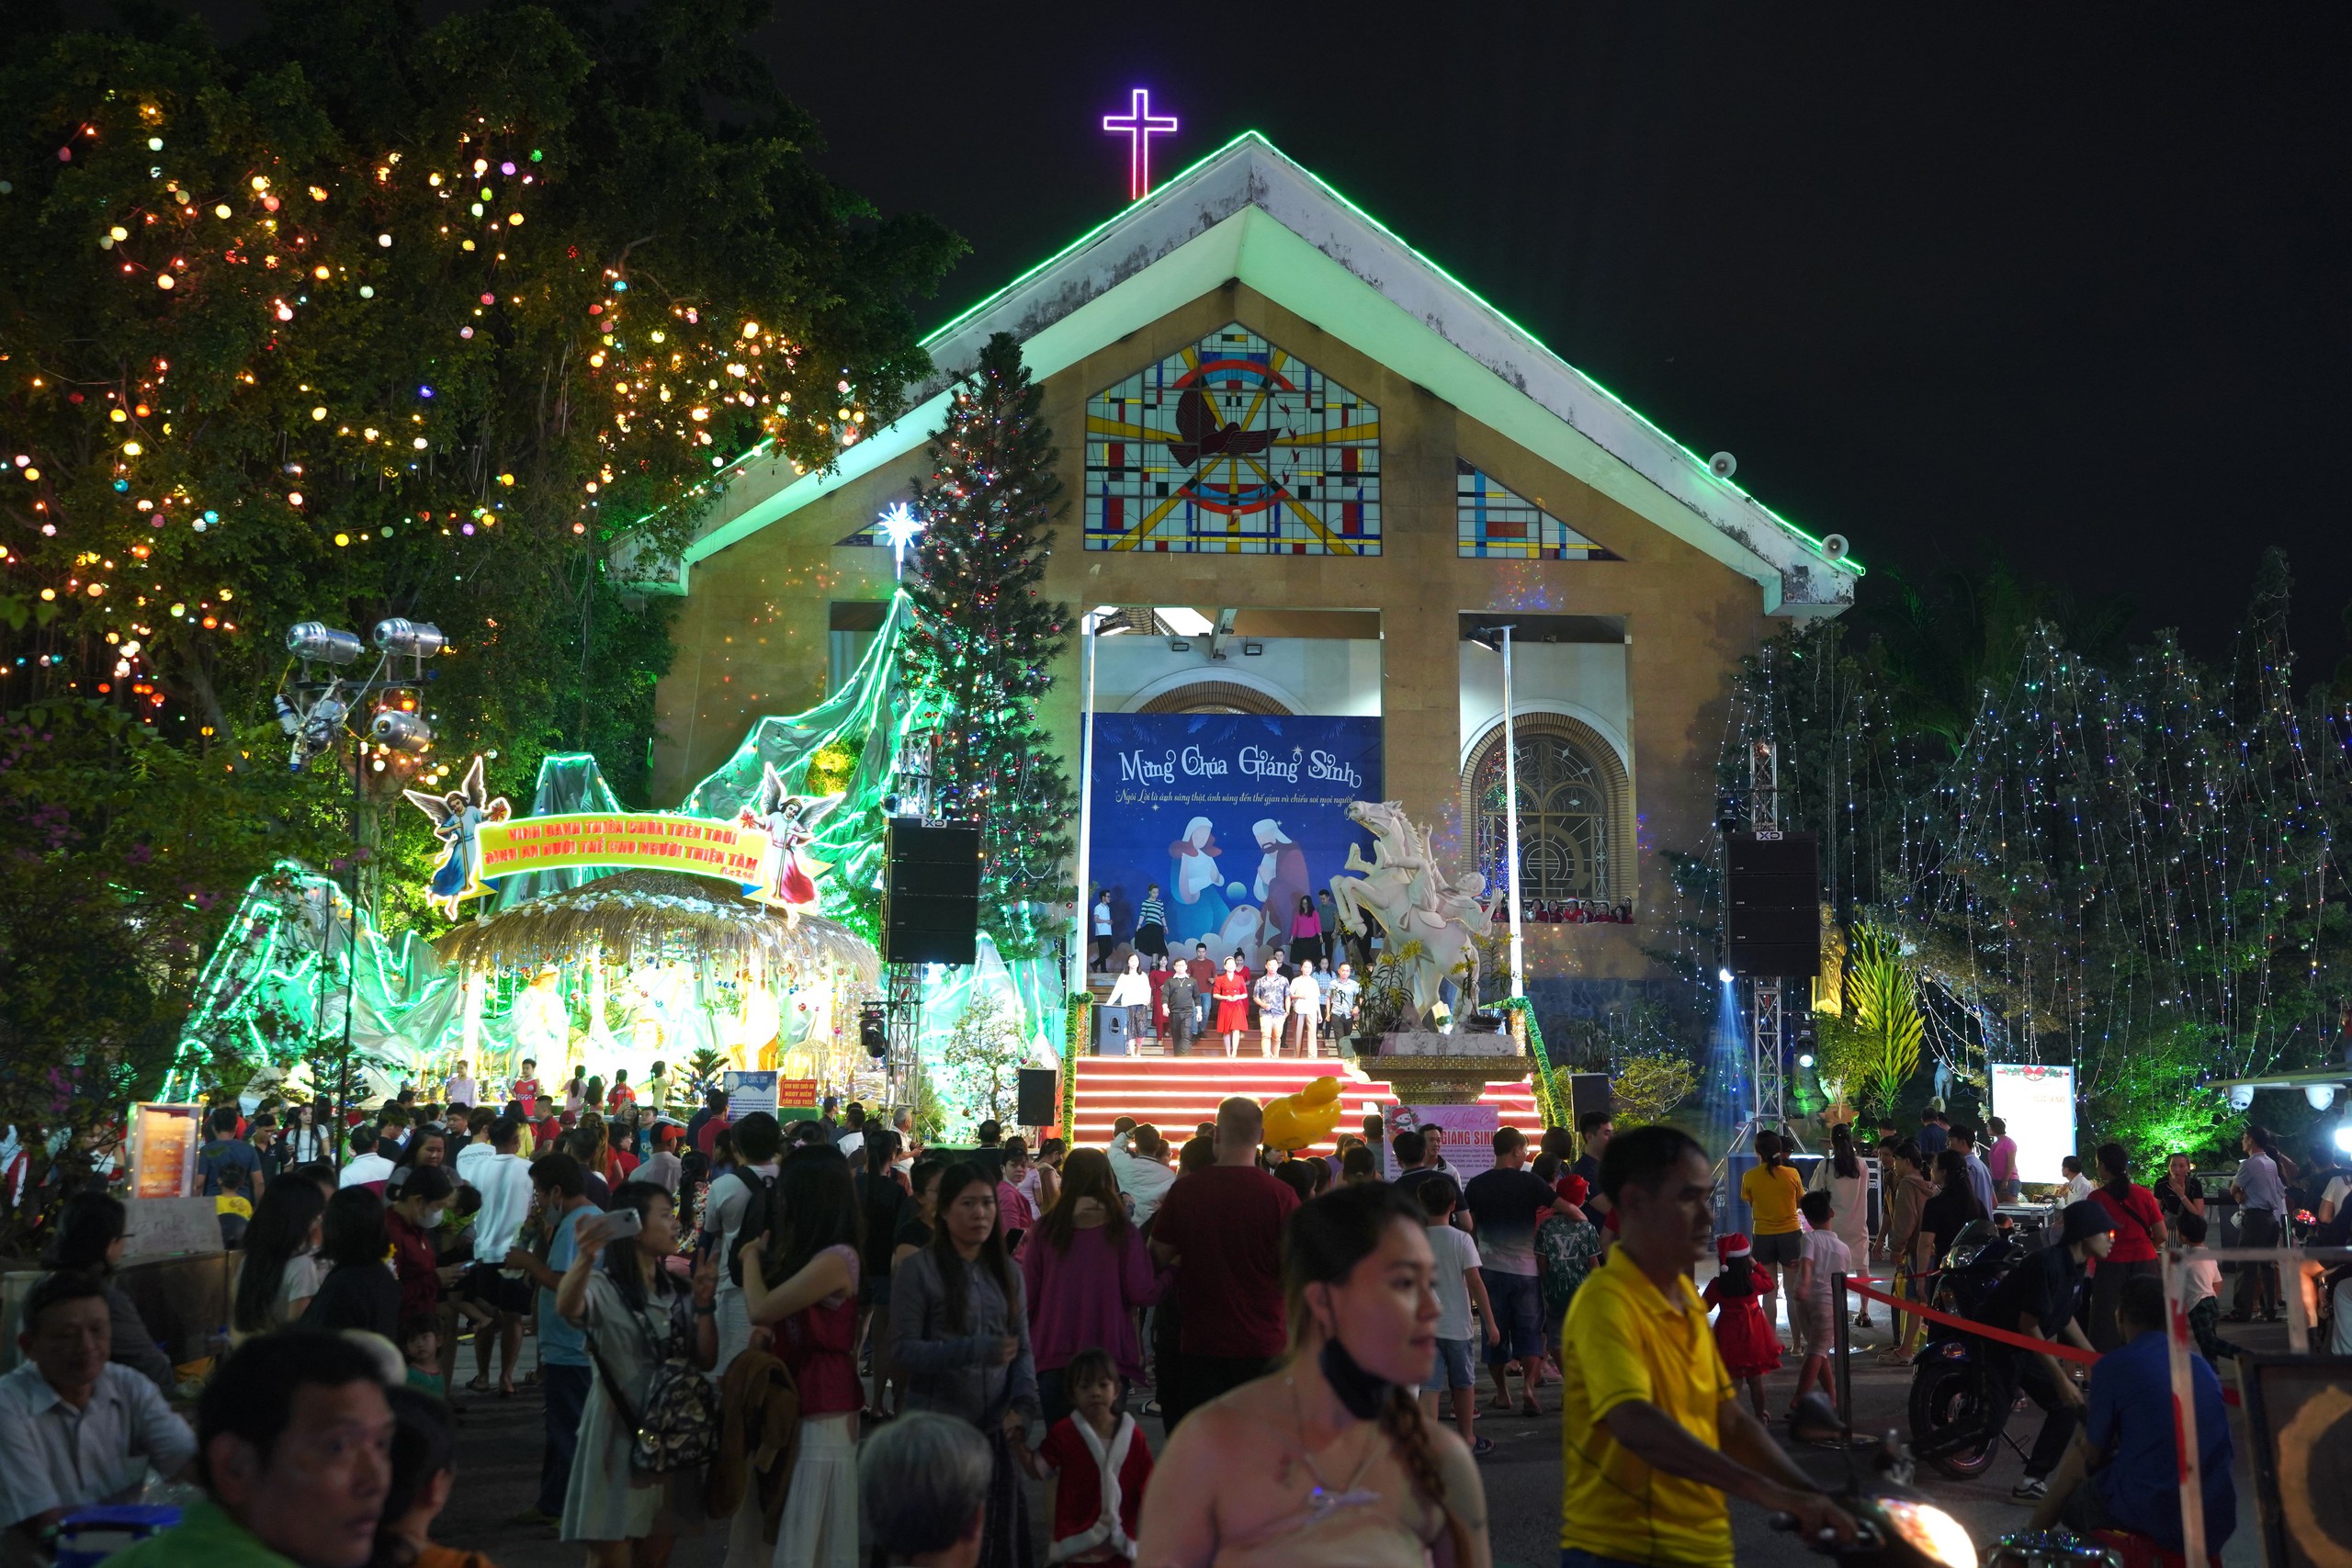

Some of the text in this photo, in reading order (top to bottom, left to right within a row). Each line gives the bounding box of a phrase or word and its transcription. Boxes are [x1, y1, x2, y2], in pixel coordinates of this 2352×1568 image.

[1118, 744, 1363, 788] Mừng Chúa Giáng Sinh
[1150, 793, 1159, 803] là
[1159, 792, 1173, 802] ánh
[1173, 794, 1192, 806] sáng
[1206, 792, 1221, 802] ánh
[1221, 794, 1238, 806] sáng
[1238, 792, 1251, 803] đến
[1252, 792, 1264, 803] thế
[1281, 795, 1290, 803] và
[507, 818, 739, 846] VINH DANH THIÊN CHÚA TRÊN TRỜI
[520, 844, 540, 859] AN
[542, 839, 577, 856] DƯỚI
[579, 837, 605, 854] THẾ
[607, 840, 638, 854] CHO
[638, 840, 684, 859] NGƯỜI
[685, 845, 727, 865] THIỆN
[729, 852, 759, 872] TÂM
[1441, 1127, 1471, 1145] GIÁNG
